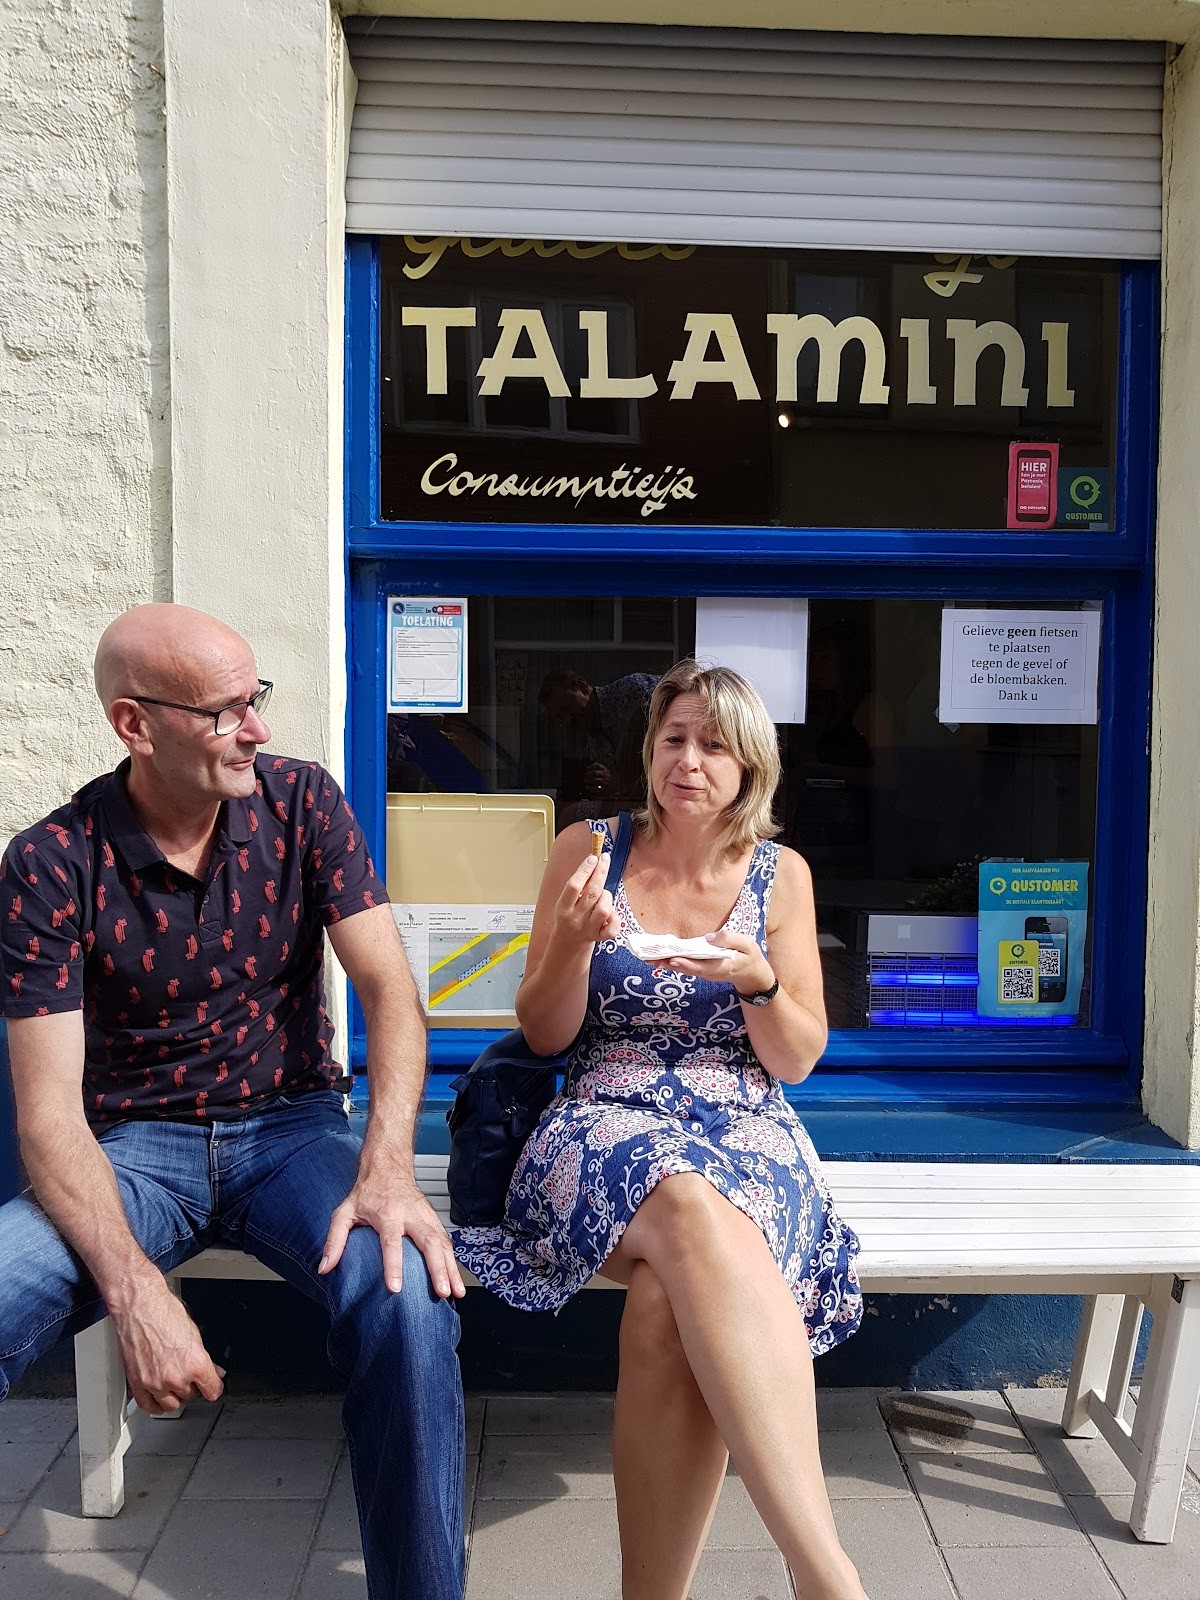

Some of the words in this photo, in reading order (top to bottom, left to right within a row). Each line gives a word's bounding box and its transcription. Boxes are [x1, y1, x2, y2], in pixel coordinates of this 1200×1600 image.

[1021, 462, 1047, 472] HIER
[421, 453, 699, 517] Consumptieijs
[401, 616, 454, 627] TOELATING
[962, 625, 1005, 636] Gelieve
[1007, 628, 1036, 639] geen
[1040, 626, 1078, 638] fietsen
[989, 643, 1000, 652] te
[1003, 642, 1051, 654] plaatsen
[971, 658, 1003, 670] tegen
[1006, 658, 1020, 669] de
[1022, 659, 1053, 671] gevel
[1055, 659, 1069, 670] of
[970, 673, 984, 684] de
[987, 674, 1067, 686] bloembakken.
[998, 690, 1028, 701] Dank
[1031, 693, 1038, 701] u
[1011, 879, 1078, 893] QUSTOMER
